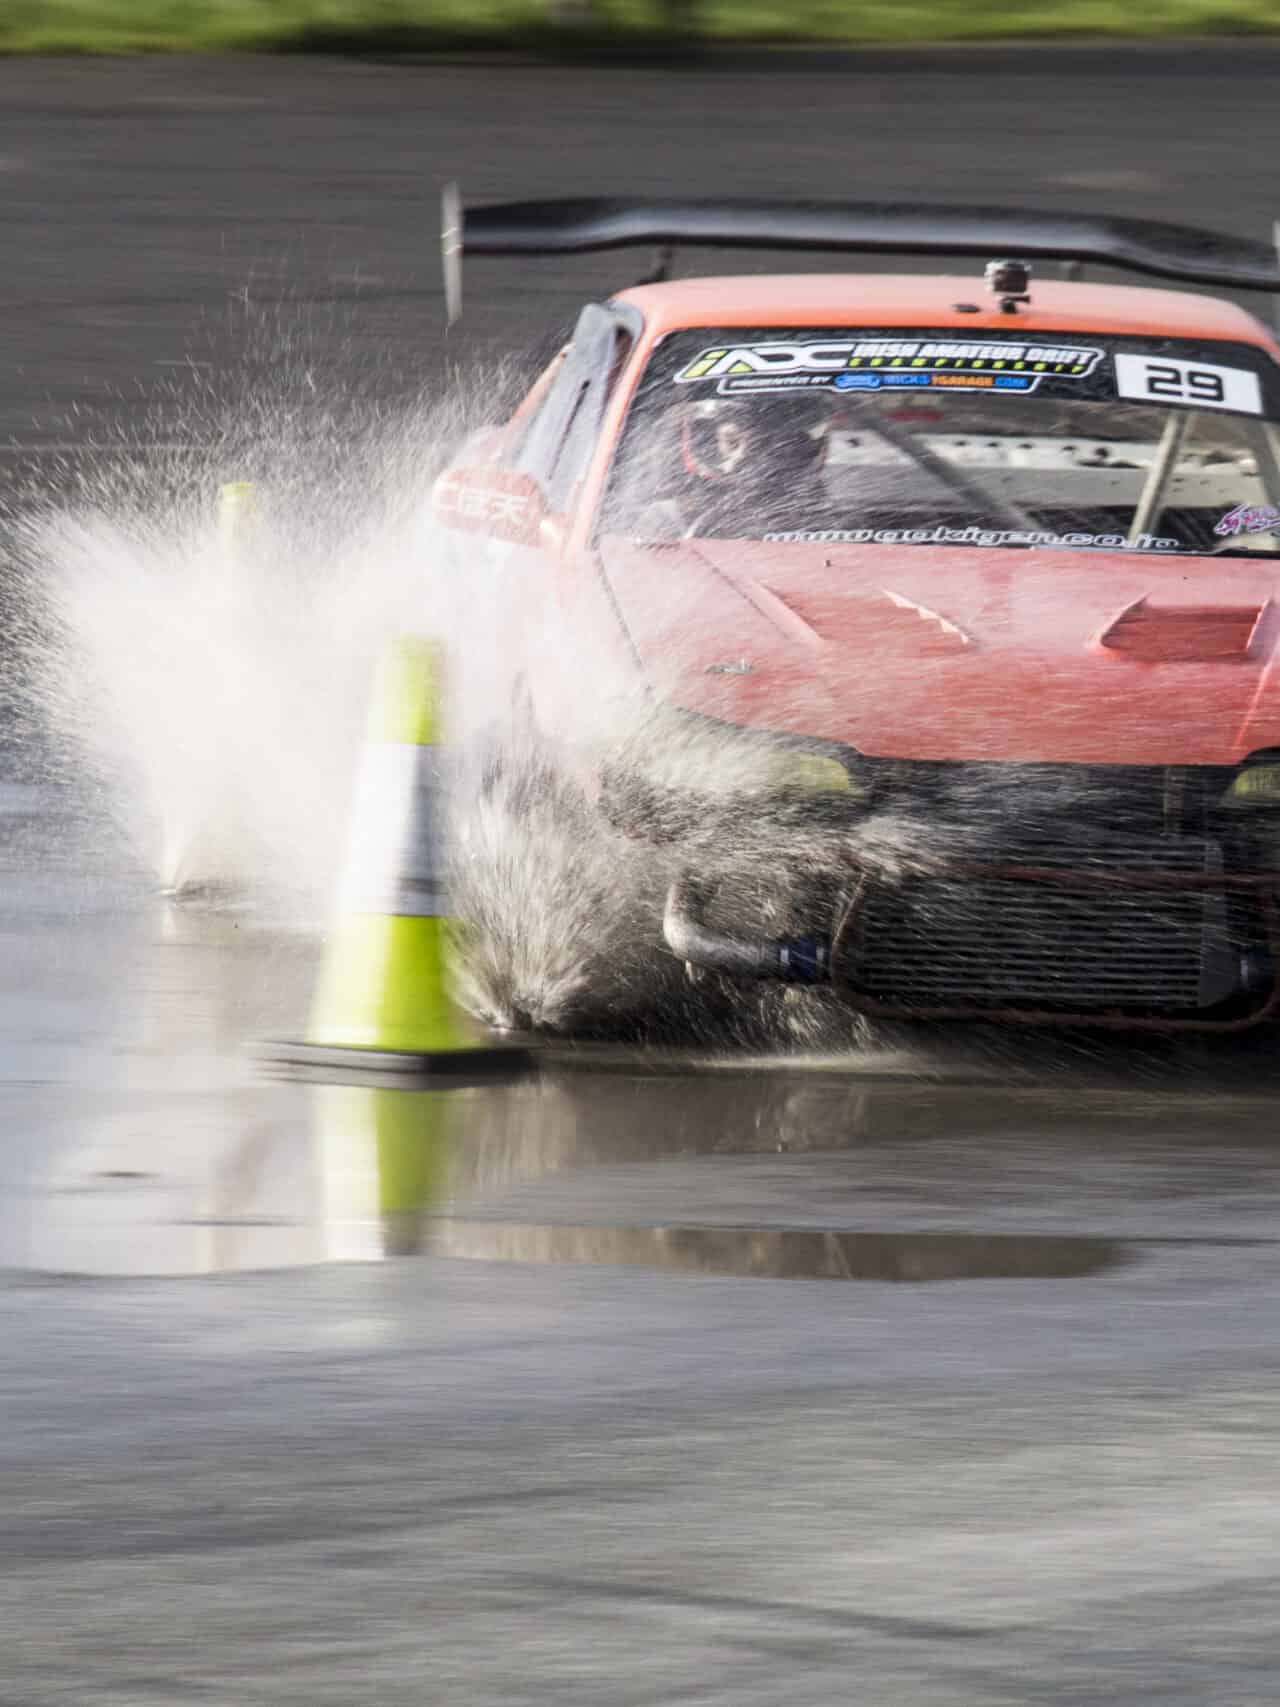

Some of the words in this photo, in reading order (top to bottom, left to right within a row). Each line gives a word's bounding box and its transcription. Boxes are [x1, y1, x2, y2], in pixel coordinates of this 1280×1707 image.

[852, 343, 920, 359] IRISH
[917, 343, 1026, 362] AMATEUR
[1023, 347, 1096, 365] DRIFT
[1146, 364, 1225, 402] 29
